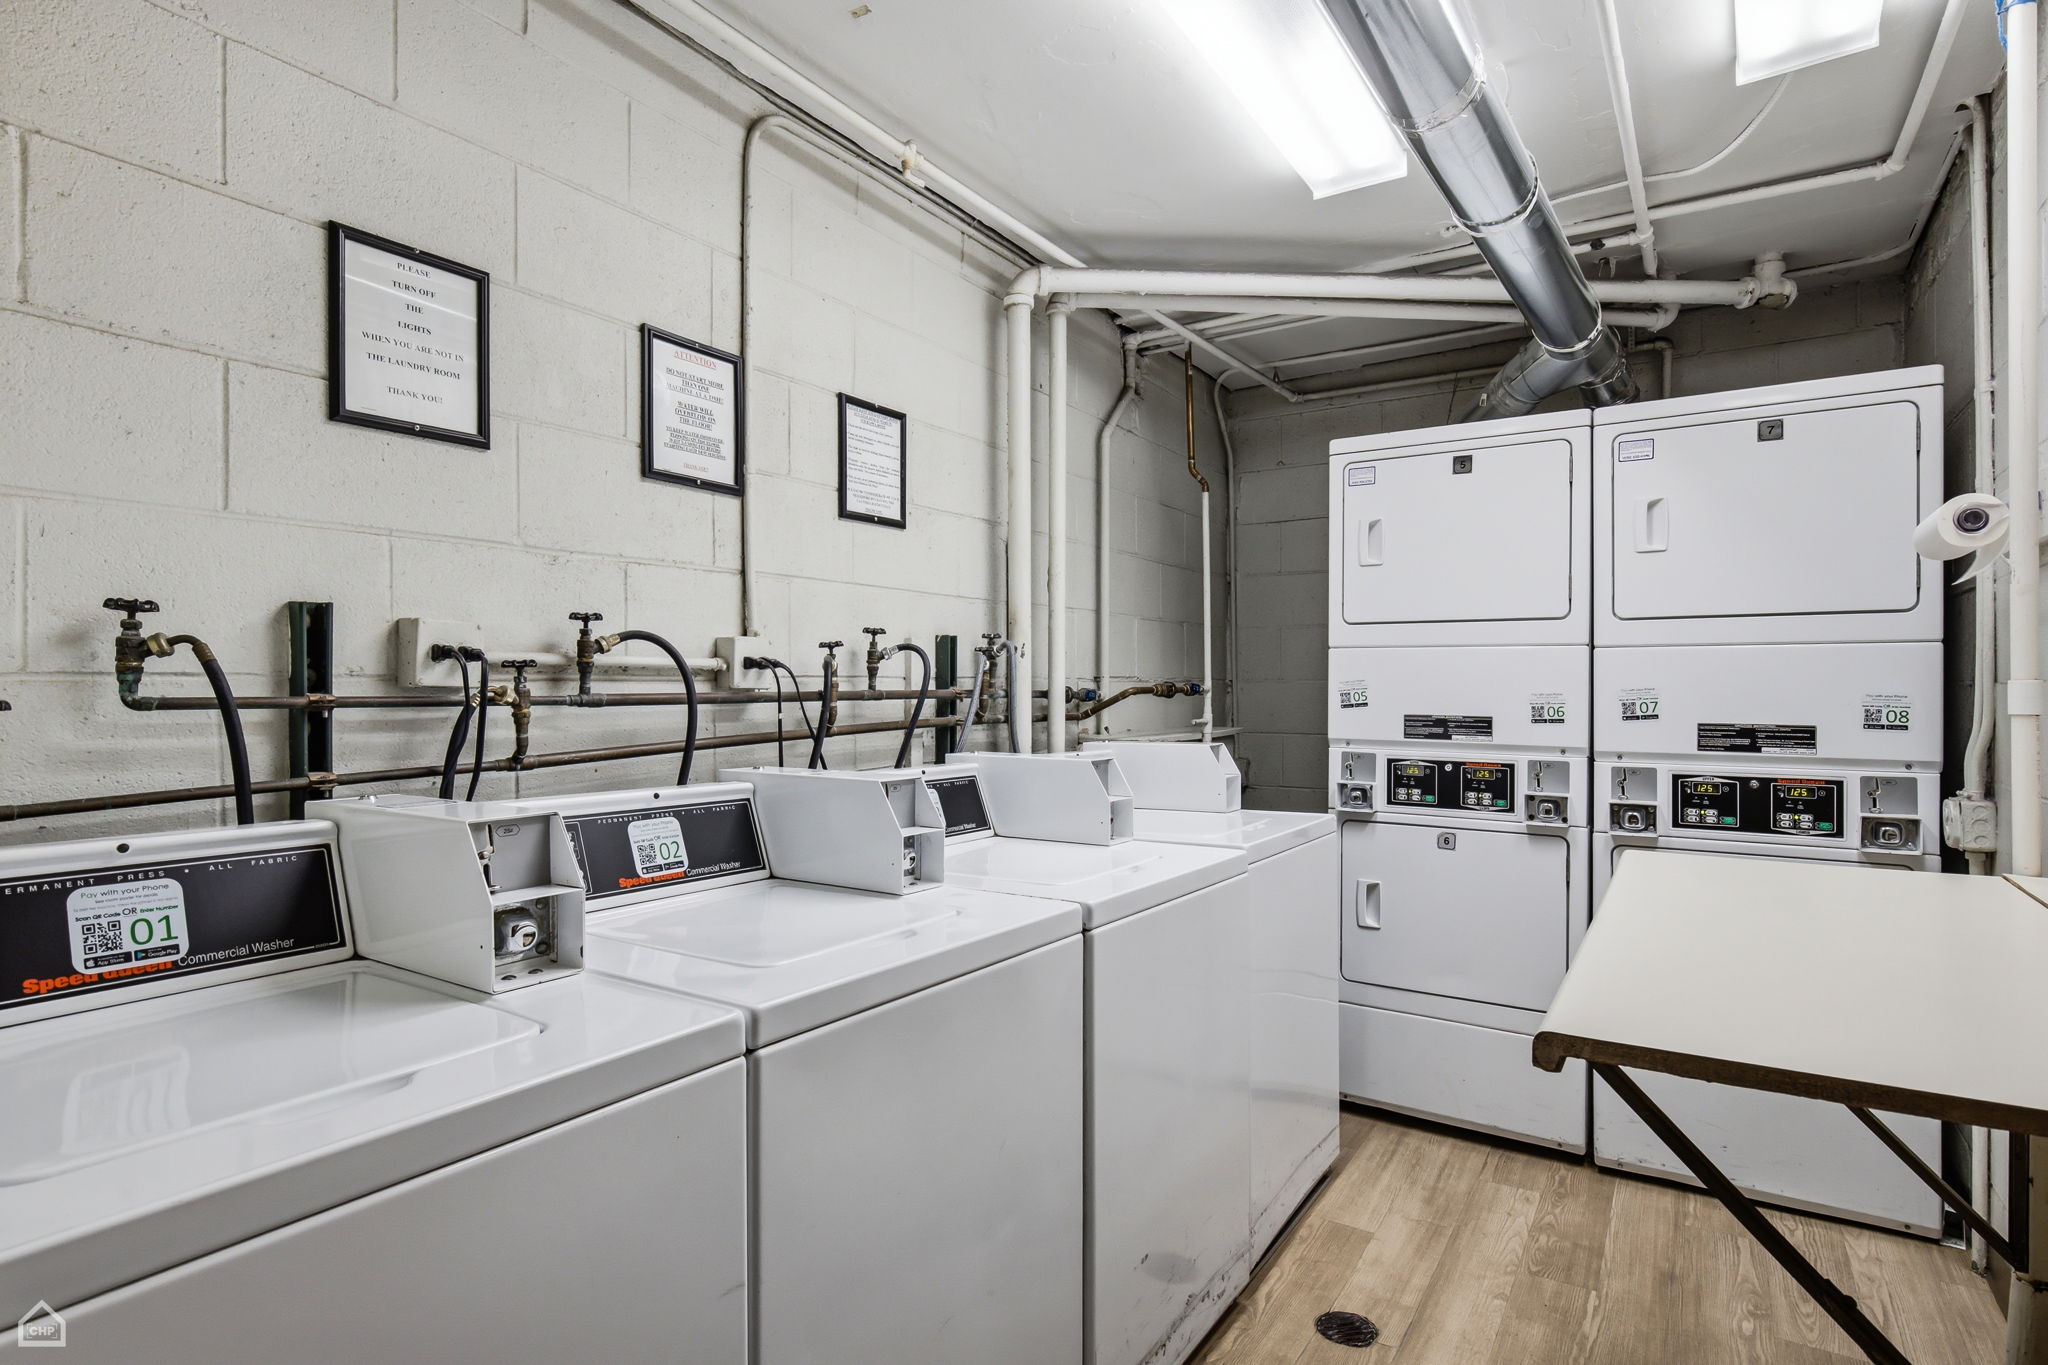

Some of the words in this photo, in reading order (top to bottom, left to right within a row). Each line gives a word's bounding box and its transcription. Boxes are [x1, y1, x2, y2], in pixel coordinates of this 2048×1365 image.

[397, 262, 431, 278] PLEASE
[392, 280, 417, 293] TURN
[419, 288, 436, 298] OFF
[405, 303, 424, 314] THE
[398, 320, 432, 335] LIGHTS
[361, 331, 391, 344] WHEN
[393, 338, 413, 350] YOU
[415, 345, 433, 355] ARE
[435, 349, 453, 360] NOT
[455, 354, 464, 362] IN
[366, 351, 386, 362] THE
[388, 357, 432, 373] LAUNDRY
[434, 367, 461, 380] ROOM
[674, 350, 717, 369] ATTENTION
[387, 386, 419, 399] THANK
[421, 393, 443, 404] YOU!
[1767, 425, 1775, 434] 7
[1459, 460, 1466, 469] 5
[1353, 691, 1368, 702] 05
[1547, 706, 1565, 718] 06
[1640, 701, 1658, 714] 07
[1886, 709, 1910, 723] 08
[1406, 766, 1419, 774] 125
[1476, 770, 1490, 778] 125
[1697, 784, 1713, 792] 125
[1790, 788, 1807, 797] 125
[1443, 836, 1450, 846] 6
[659, 840, 682, 860] 02
[209, 863, 233, 871] ALL
[251, 855, 298, 866] FABRIC
[686, 863, 720, 877] Commercial
[720, 860, 741, 871] Washer
[117, 870, 166, 882] PRESS
[80, 892, 98, 900] Pay
[100, 888, 118, 897] with
[121, 887, 140, 896] your
[142, 883, 170, 892] Phone
[122, 907, 138, 916] OR
[155, 904, 179, 912] Number
[130, 914, 179, 946] 01
[177, 943, 250, 967] Commercial
[251, 938, 295, 953] Washer
[22, 973, 99, 995] Speed
